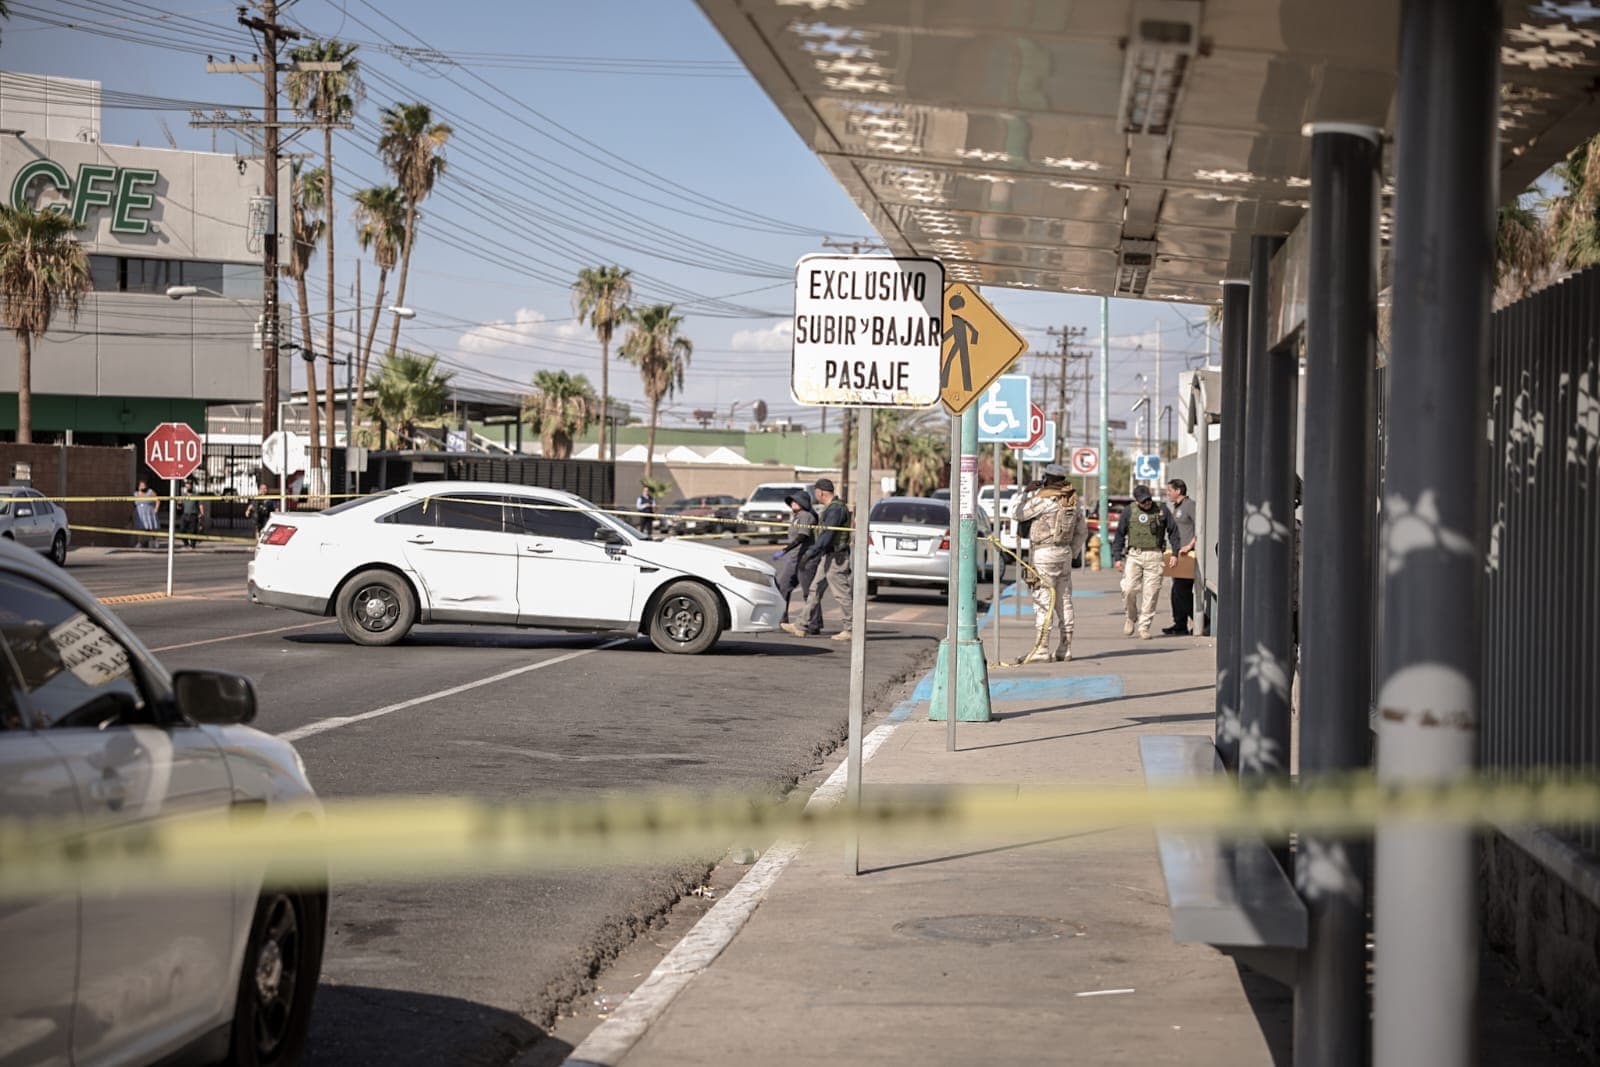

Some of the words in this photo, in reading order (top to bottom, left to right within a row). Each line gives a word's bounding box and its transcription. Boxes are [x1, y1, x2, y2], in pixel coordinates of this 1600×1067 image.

[10, 158, 159, 234] CFE
[810, 270, 926, 302] EXCLUSIVO
[796, 315, 856, 345] SUBIR
[872, 316, 940, 347] BAJAR
[825, 360, 910, 391] PASAJE
[150, 440, 197, 462] ALTO
